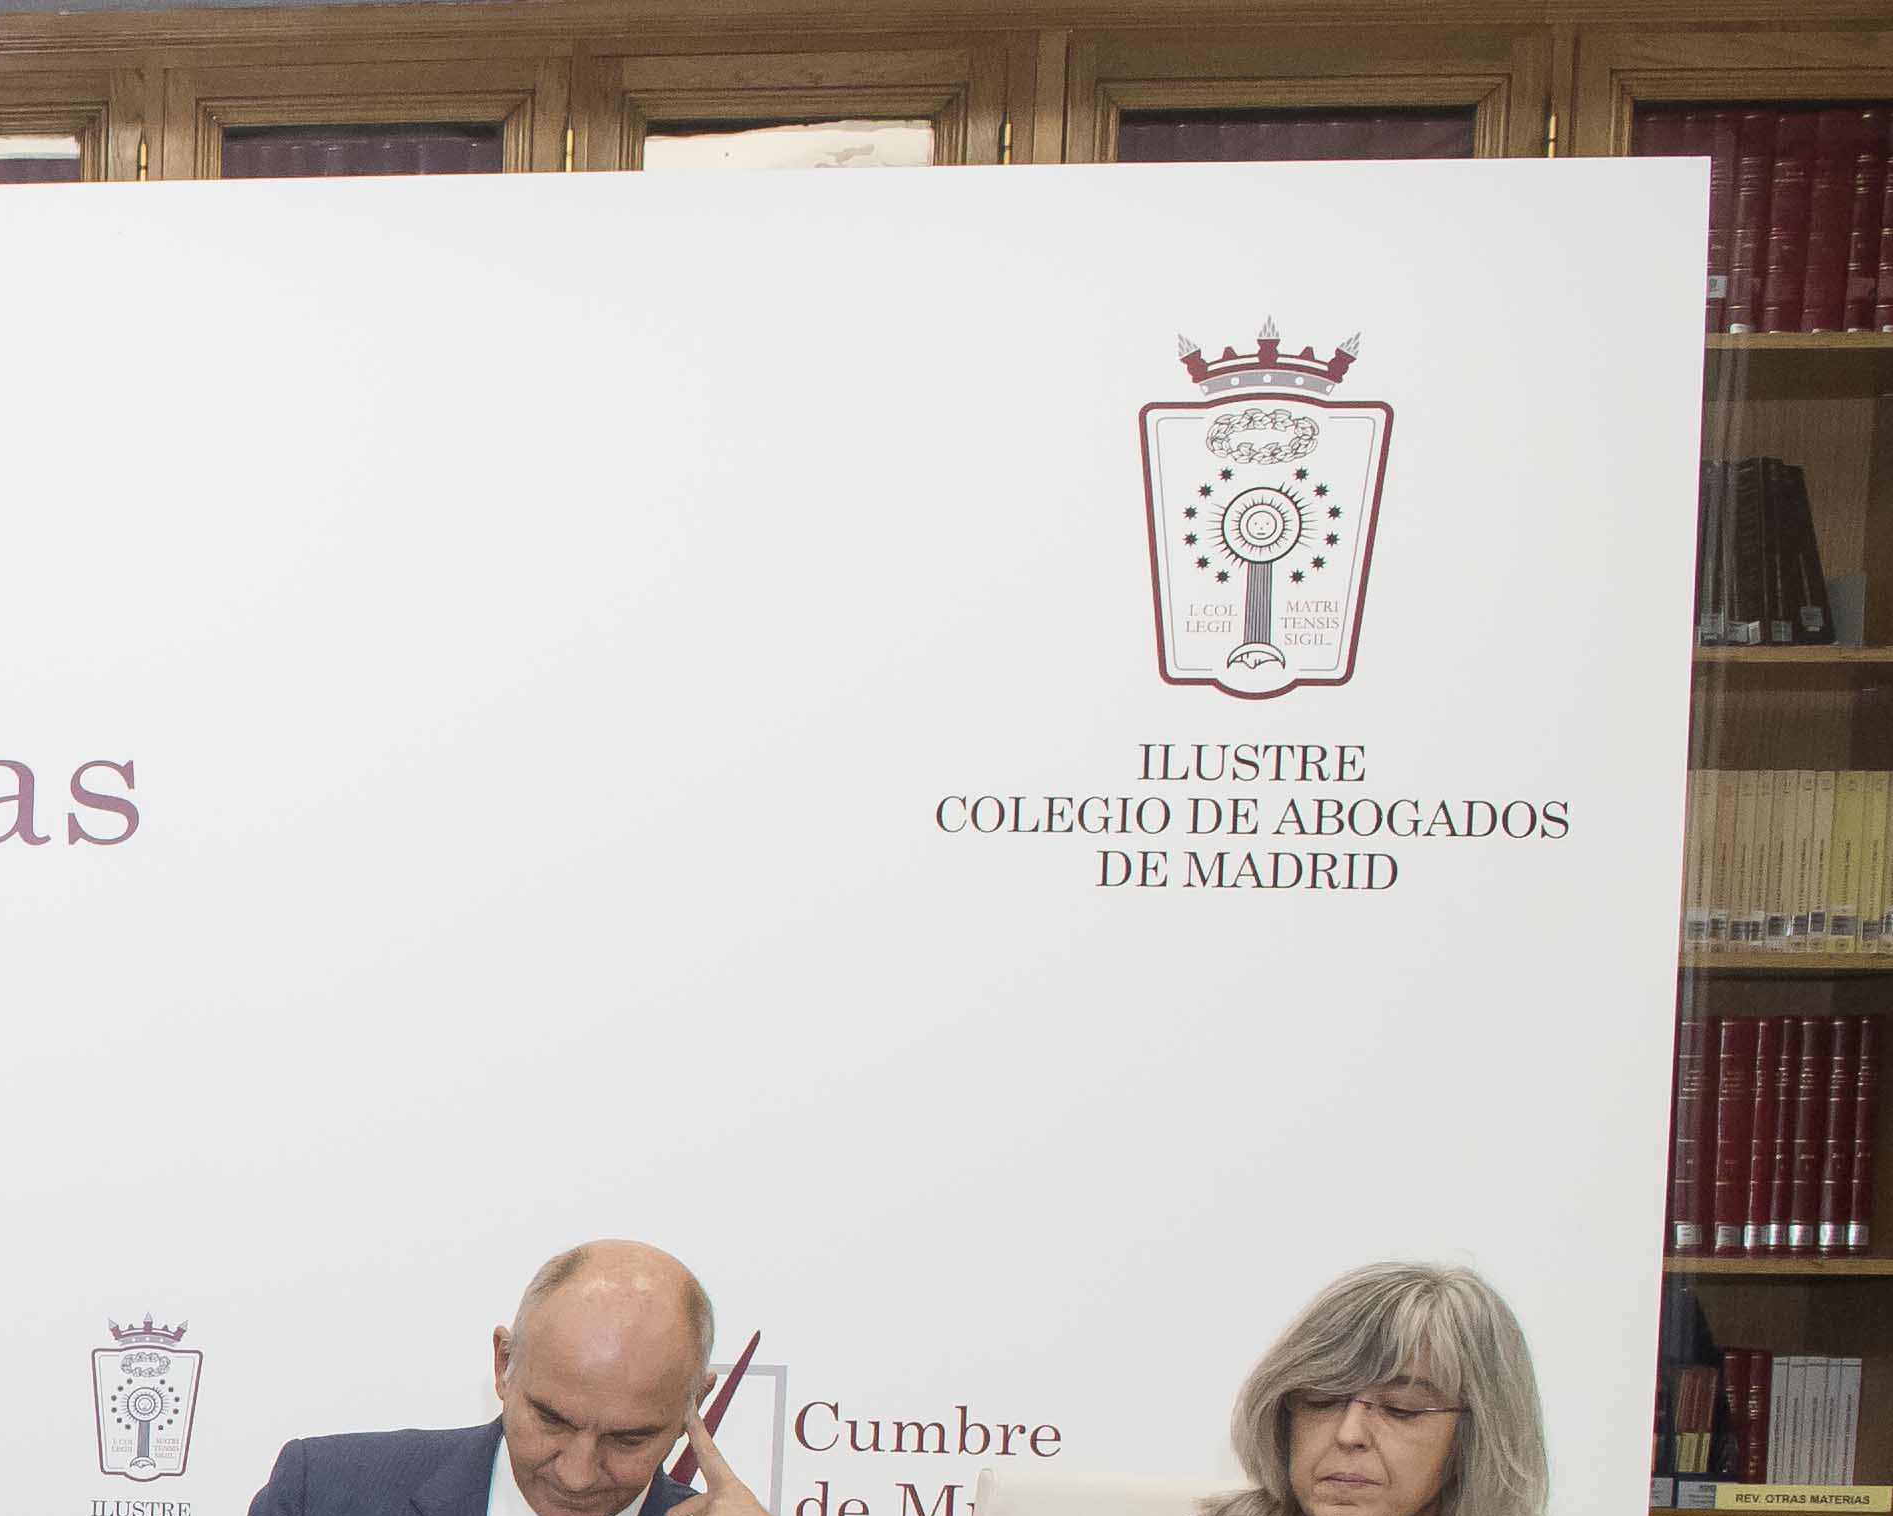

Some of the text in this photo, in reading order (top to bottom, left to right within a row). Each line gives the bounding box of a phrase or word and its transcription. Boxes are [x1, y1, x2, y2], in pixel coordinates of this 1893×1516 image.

[1202, 603, 1237, 618] COL
[1287, 601, 1338, 612] MATRI
[1186, 621, 1231, 632] LEGII
[1280, 617, 1339, 629] TENSIS
[1285, 634, 1331, 645] SIGIL.
[1139, 744, 1365, 781] ILUSTRE
[936, 796, 1569, 838] COLEGIO DE ABOGADOS
[1098, 851, 1398, 889] DE MADRID
[795, 1402, 1061, 1457] Cumbre
[1766, 1494, 1806, 1504] OTRAS
[1810, 1495, 1870, 1505] MATERIAS
